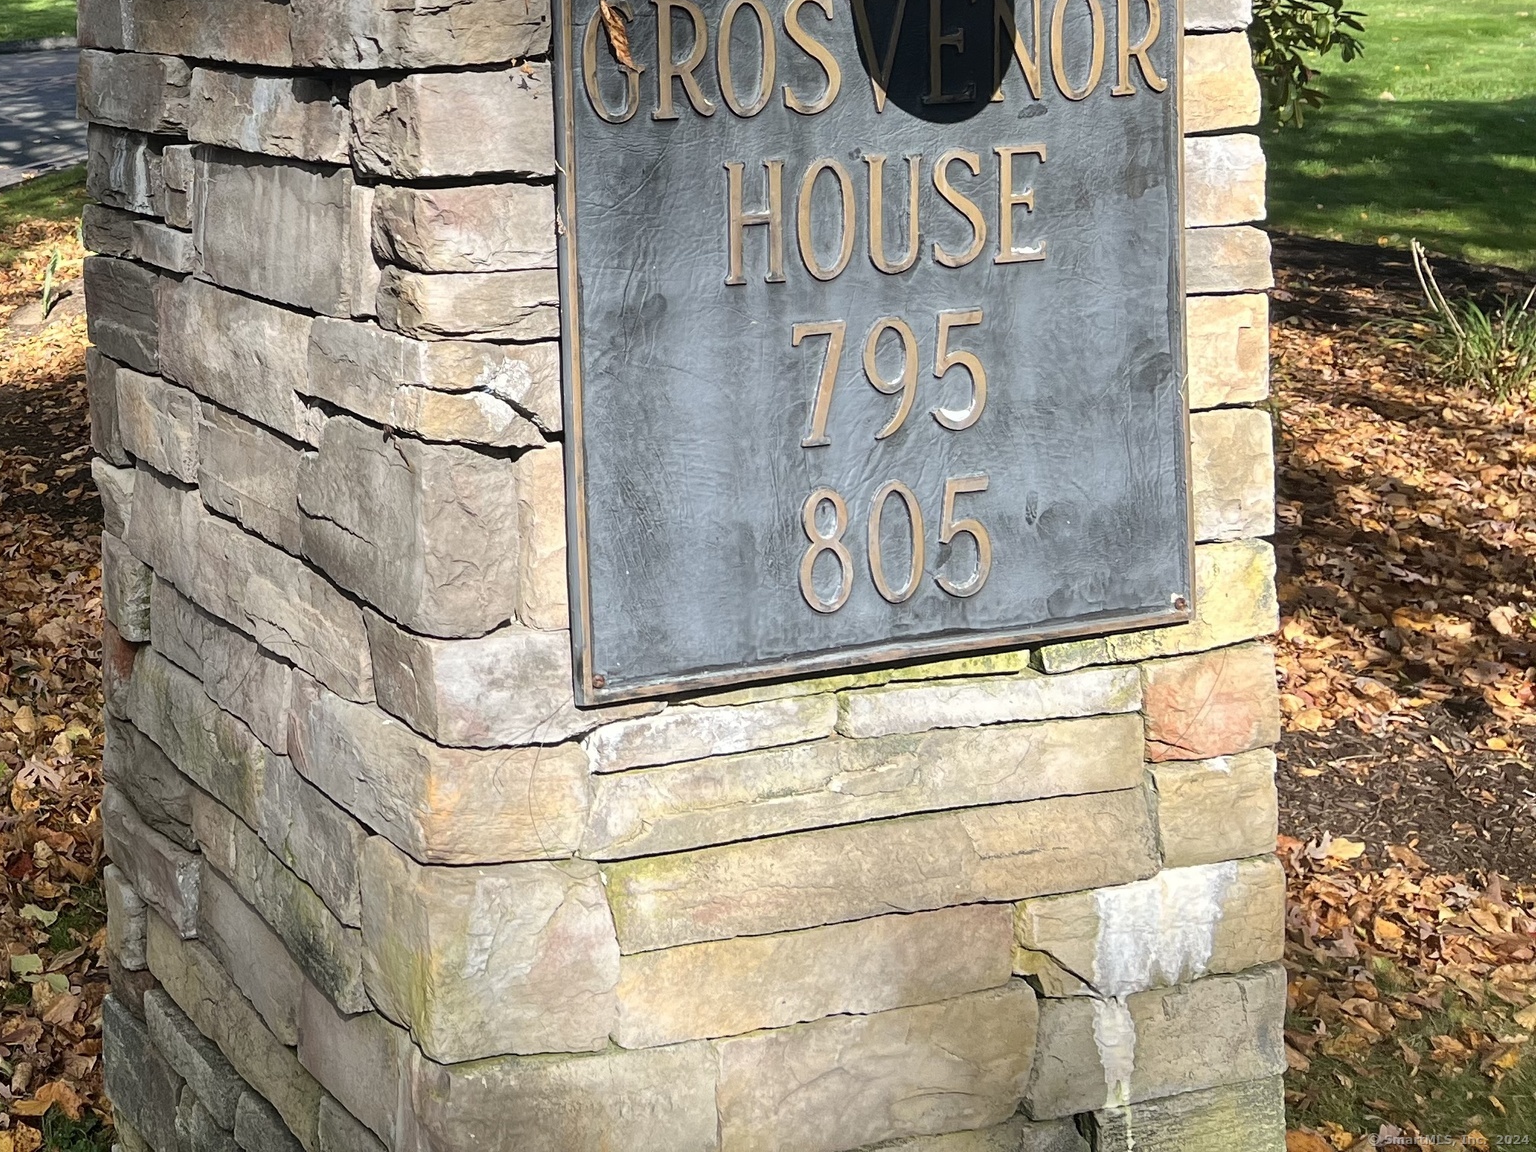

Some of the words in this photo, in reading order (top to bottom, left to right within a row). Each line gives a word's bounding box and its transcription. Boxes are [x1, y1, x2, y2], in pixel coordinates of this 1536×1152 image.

[724, 143, 1047, 286] HOUSE
[791, 307, 987, 447] 795
[800, 475, 990, 613] 805
